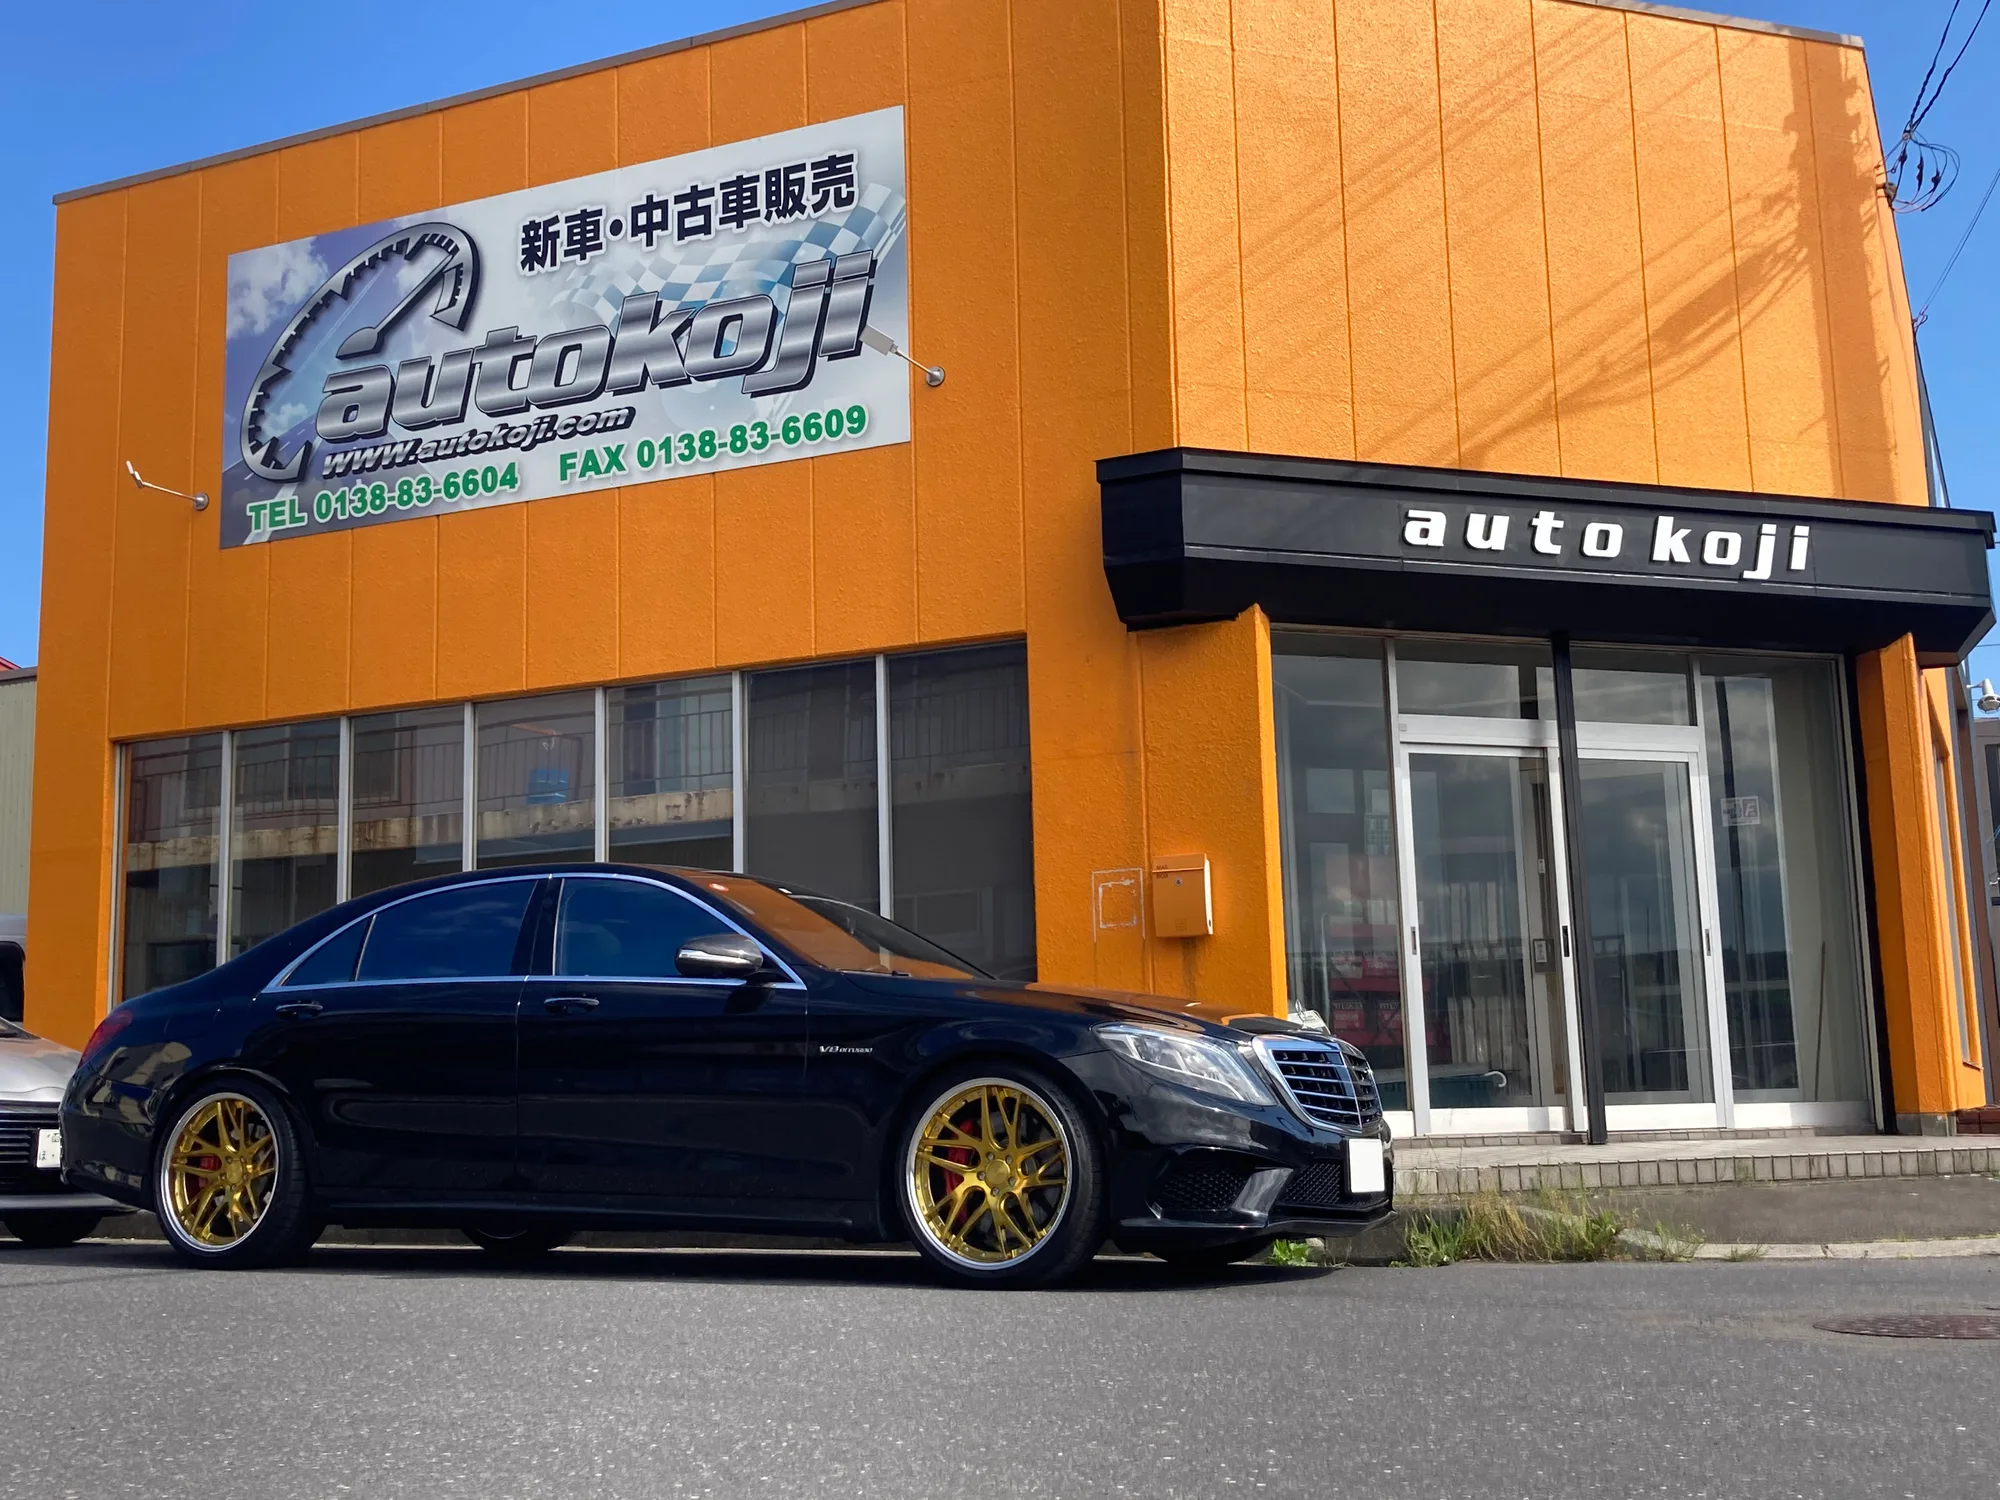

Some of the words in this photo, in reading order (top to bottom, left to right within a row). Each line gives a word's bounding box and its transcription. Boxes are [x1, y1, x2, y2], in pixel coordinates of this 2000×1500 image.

[520, 153, 856, 272] 新車・中古車販売
[315, 250, 875, 443] autokoji
[322, 405, 636, 479] www.autokoji.com
[559, 443, 627, 481] FAX
[636, 404, 867, 468] 0138-83-6609
[249, 499, 306, 531] TEL
[315, 461, 519, 520] 0138-83-6604
[1403, 509, 1624, 559] auto
[1651, 515, 1810, 580] koji
[819, 1045, 839, 1053] V8
